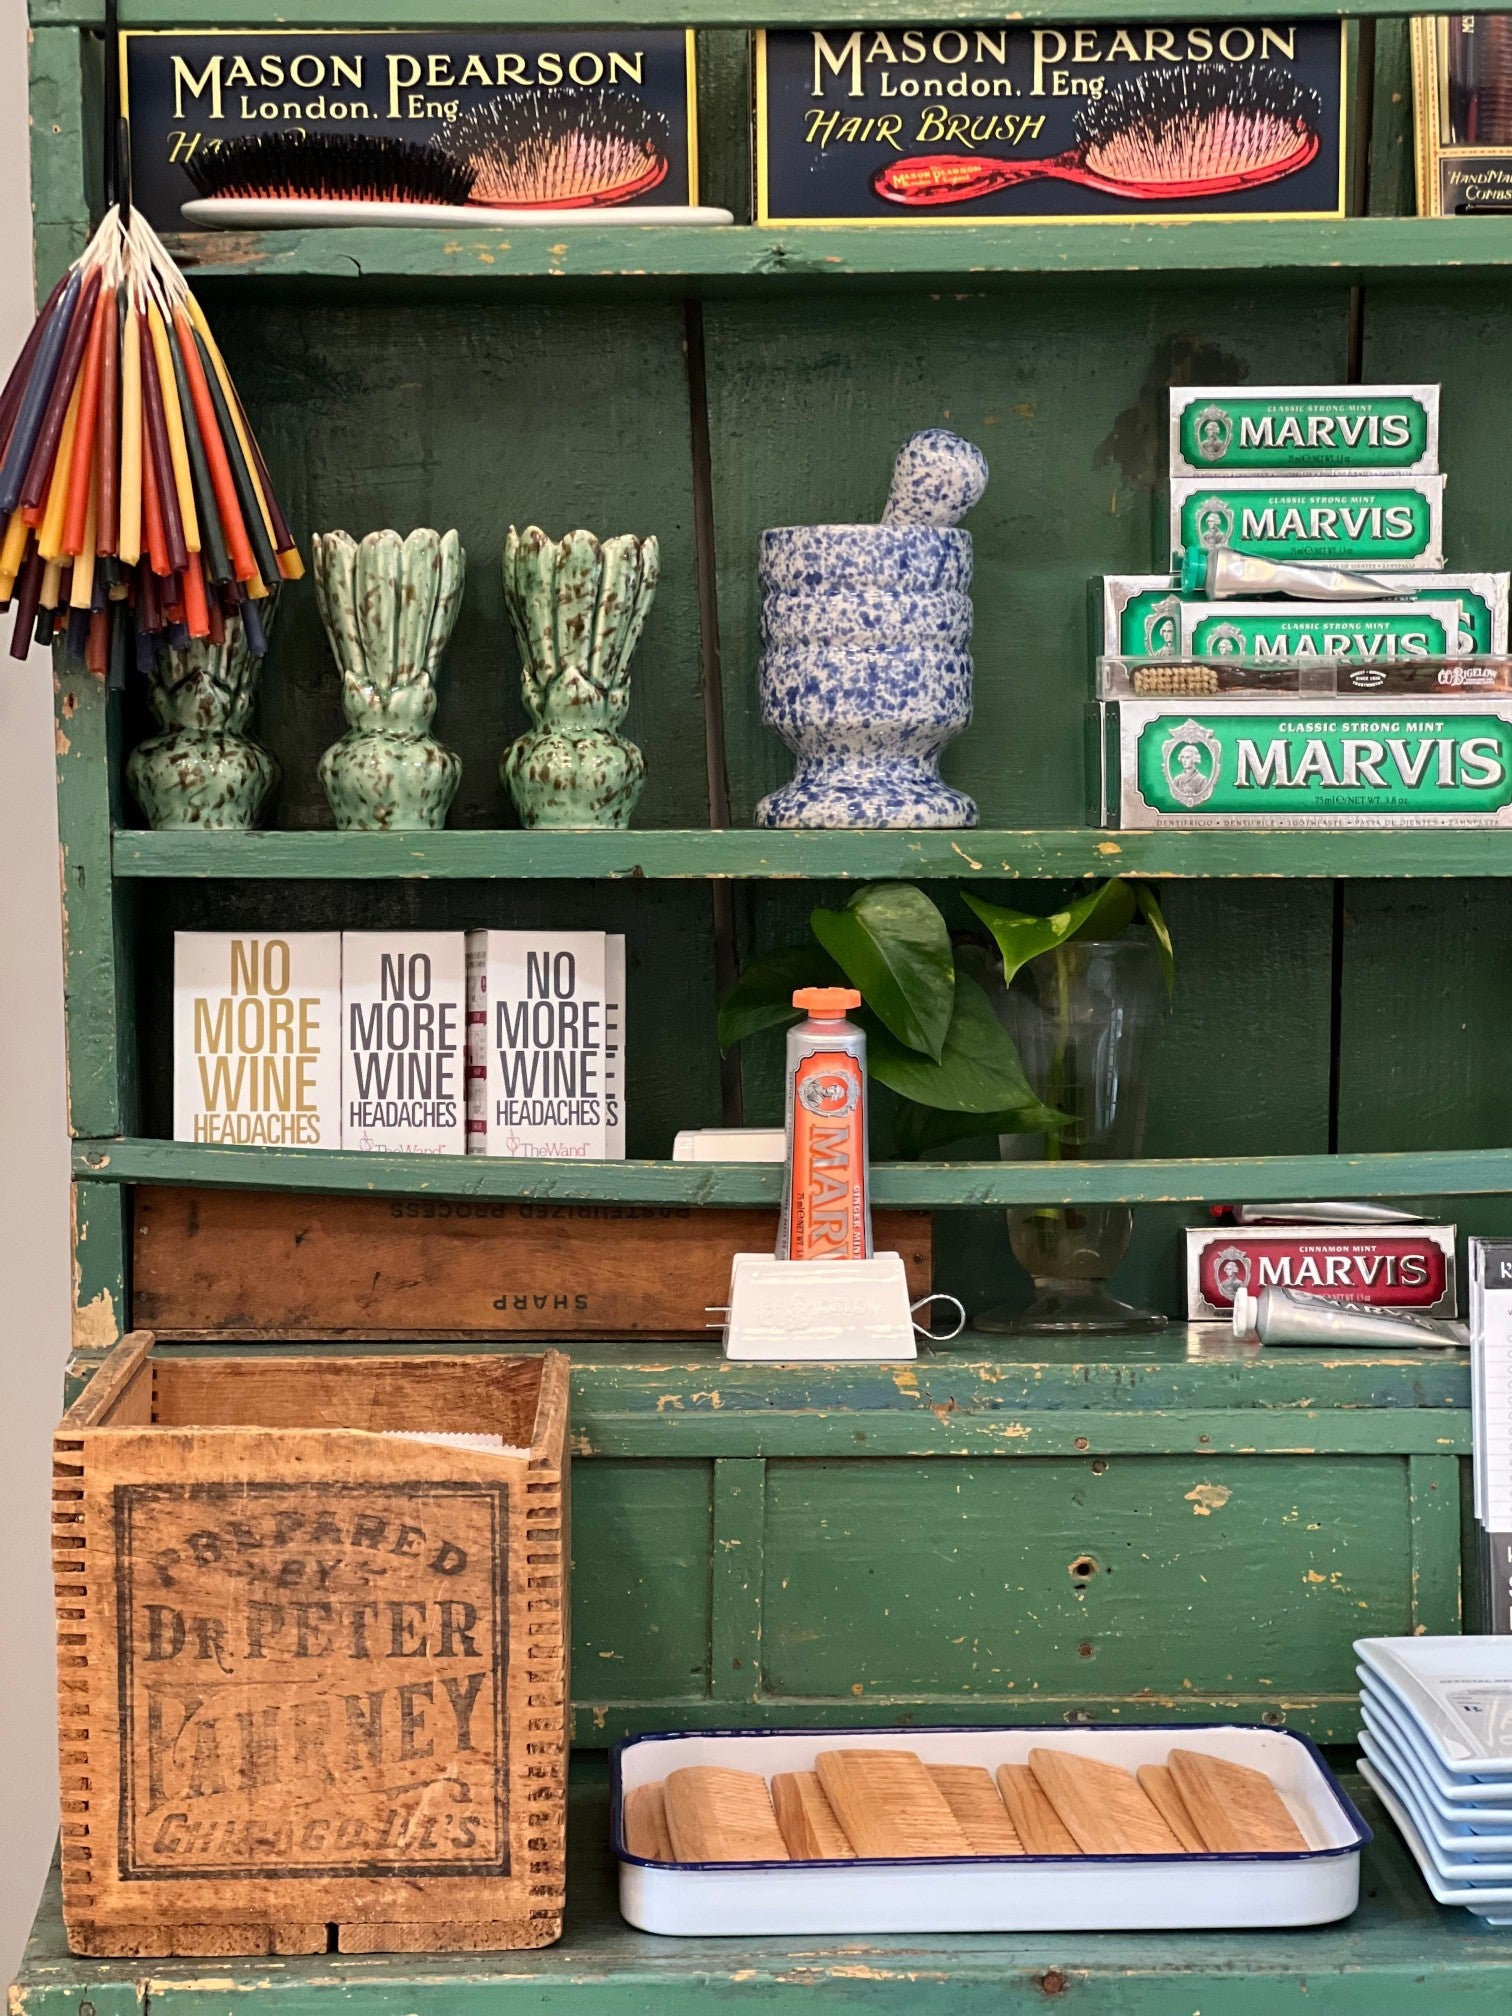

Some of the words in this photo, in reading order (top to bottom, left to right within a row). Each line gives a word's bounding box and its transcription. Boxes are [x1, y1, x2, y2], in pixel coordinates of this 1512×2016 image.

[811, 30, 1006, 96] MASON
[1030, 27, 1297, 96] PEARSON
[170, 54, 363, 119] MASON
[385, 51, 644, 119] PEARSON
[880, 72, 1021, 97] London.
[1052, 71, 1110, 99] Eng.
[240, 95, 378, 120] London.
[408, 94, 464, 122] Eng.
[804, 108, 903, 151] HAIR
[915, 104, 1046, 149] BRUSH
[1239, 415, 1411, 448] MARVIS
[1309, 496, 1347, 504] STRONG
[1240, 506, 1415, 540] MARVIS
[1323, 622, 1361, 630] STRONG
[1254, 633, 1428, 663] MARVIS
[1278, 723, 1337, 732] CLASSIC
[1341, 723, 1400, 732] STRONG
[1406, 722, 1444, 732] MINT
[1233, 737, 1506, 790] MARVIS
[230, 939, 290, 996] NO
[381, 953, 431, 1001] NO
[526, 951, 576, 999] NO
[194, 998, 321, 1054] MORE
[350, 1003, 457, 1051] MORE
[496, 1001, 600, 1049] MORE
[198, 1055, 318, 1112] WINE
[353, 1052, 455, 1100] WINE
[500, 1050, 598, 1098] WINE
[194, 1114, 321, 1145] HEADACHES
[350, 1101, 457, 1128] HEADACHES
[497, 1099, 600, 1126] HEADACHES
[391, 1203, 504, 1219] PROCESS
[852, 1185, 861, 1228] GINGER
[1258, 1255, 1428, 1287] MARVIS
[493, 1294, 588, 1310] SHARP
[244, 1600, 483, 1660] PETER
